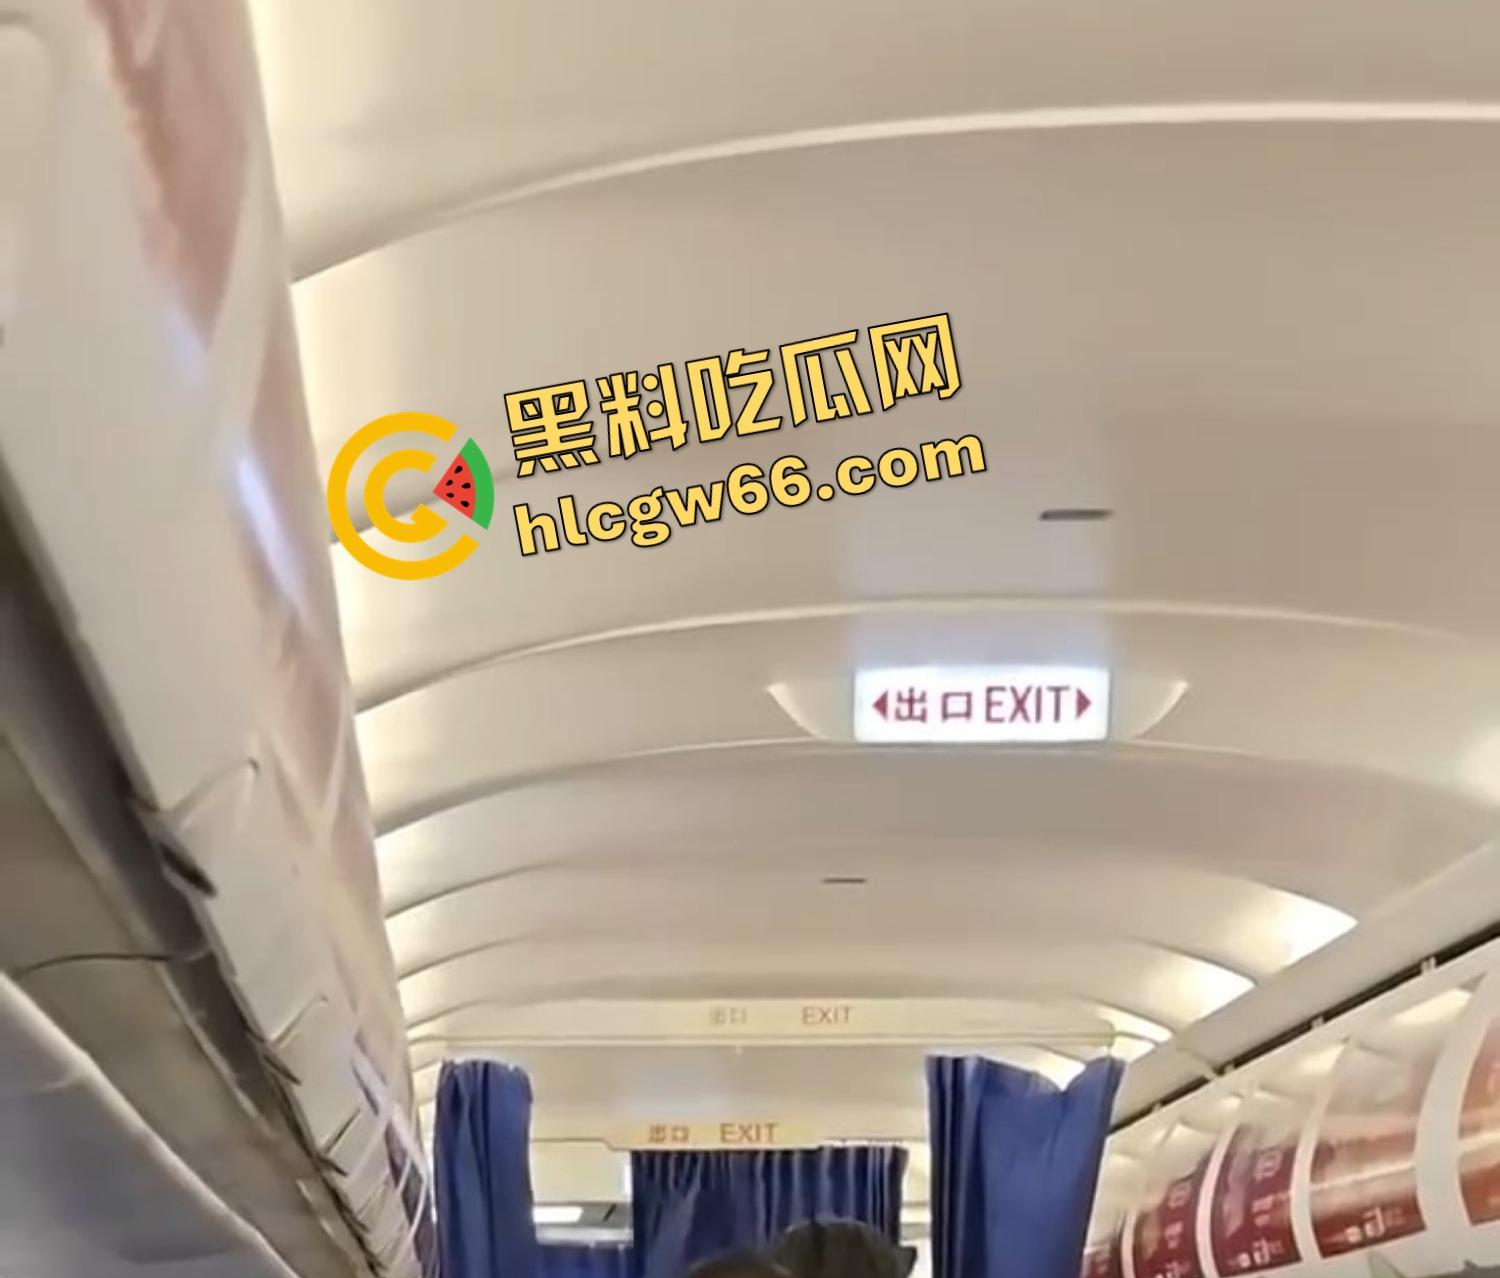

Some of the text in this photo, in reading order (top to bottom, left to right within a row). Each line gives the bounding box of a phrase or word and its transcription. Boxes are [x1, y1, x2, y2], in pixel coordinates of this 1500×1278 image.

[894, 686, 1070, 723] 出口 EXIT
[801, 1005, 853, 1026] EXIT
[719, 1122, 779, 1143] EXIT
